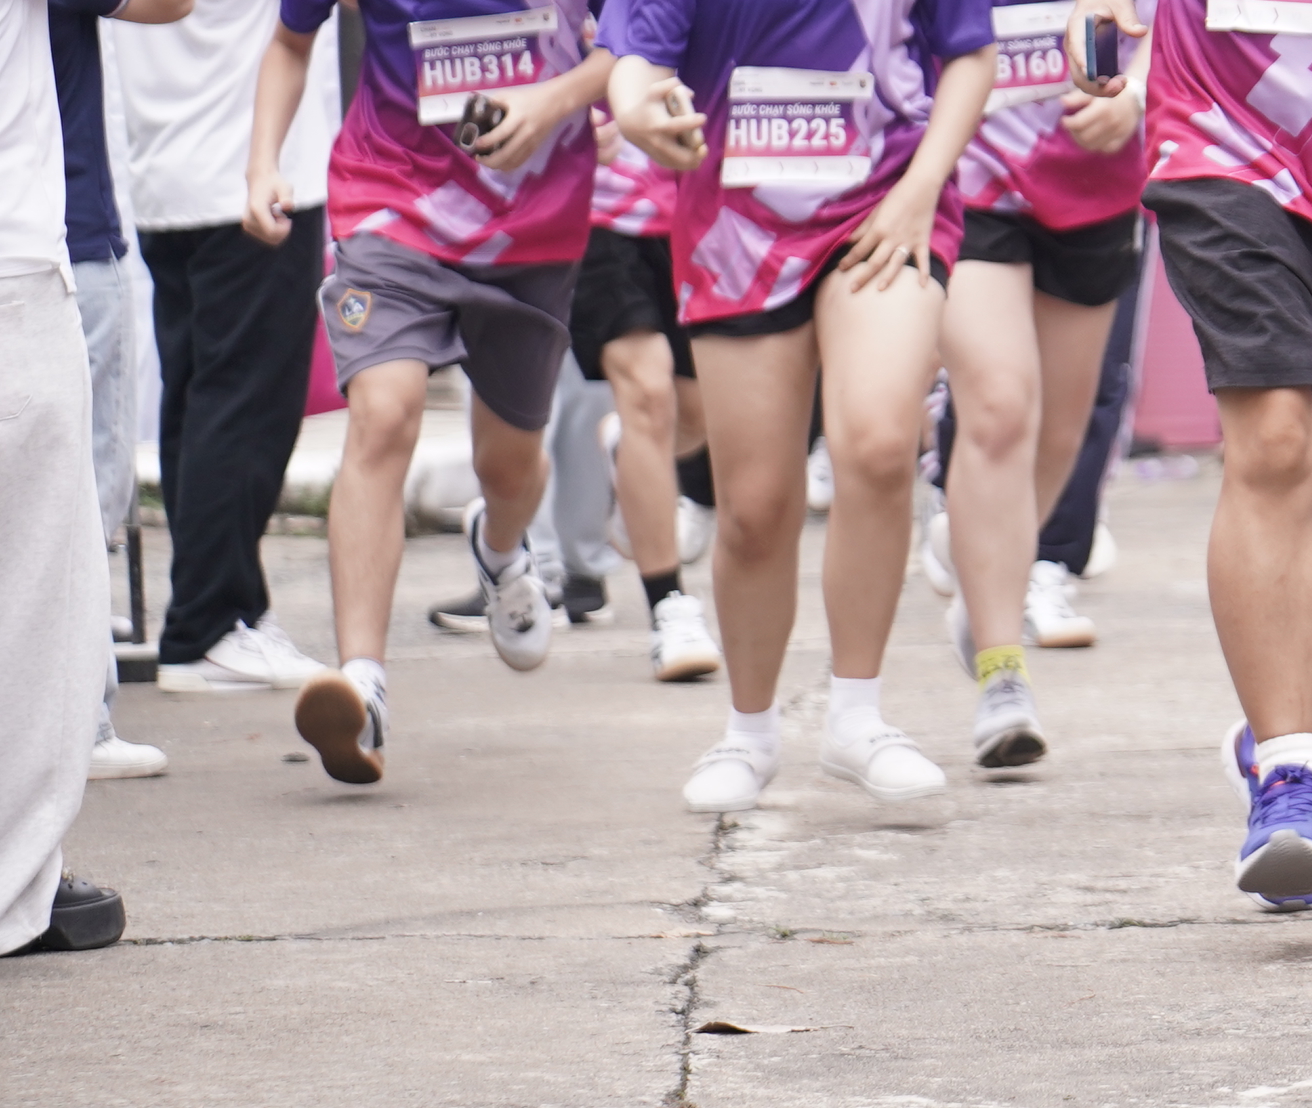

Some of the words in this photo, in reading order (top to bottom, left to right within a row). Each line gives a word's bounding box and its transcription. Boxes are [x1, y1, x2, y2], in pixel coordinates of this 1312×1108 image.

[423, 50, 534, 87] HUB314
[997, 48, 1064, 81] B160
[732, 102, 757, 115] BƯỚC
[759, 103, 785, 116] CHẠY
[786, 102, 813, 115] SỐNG
[729, 118, 847, 147] HUB225
